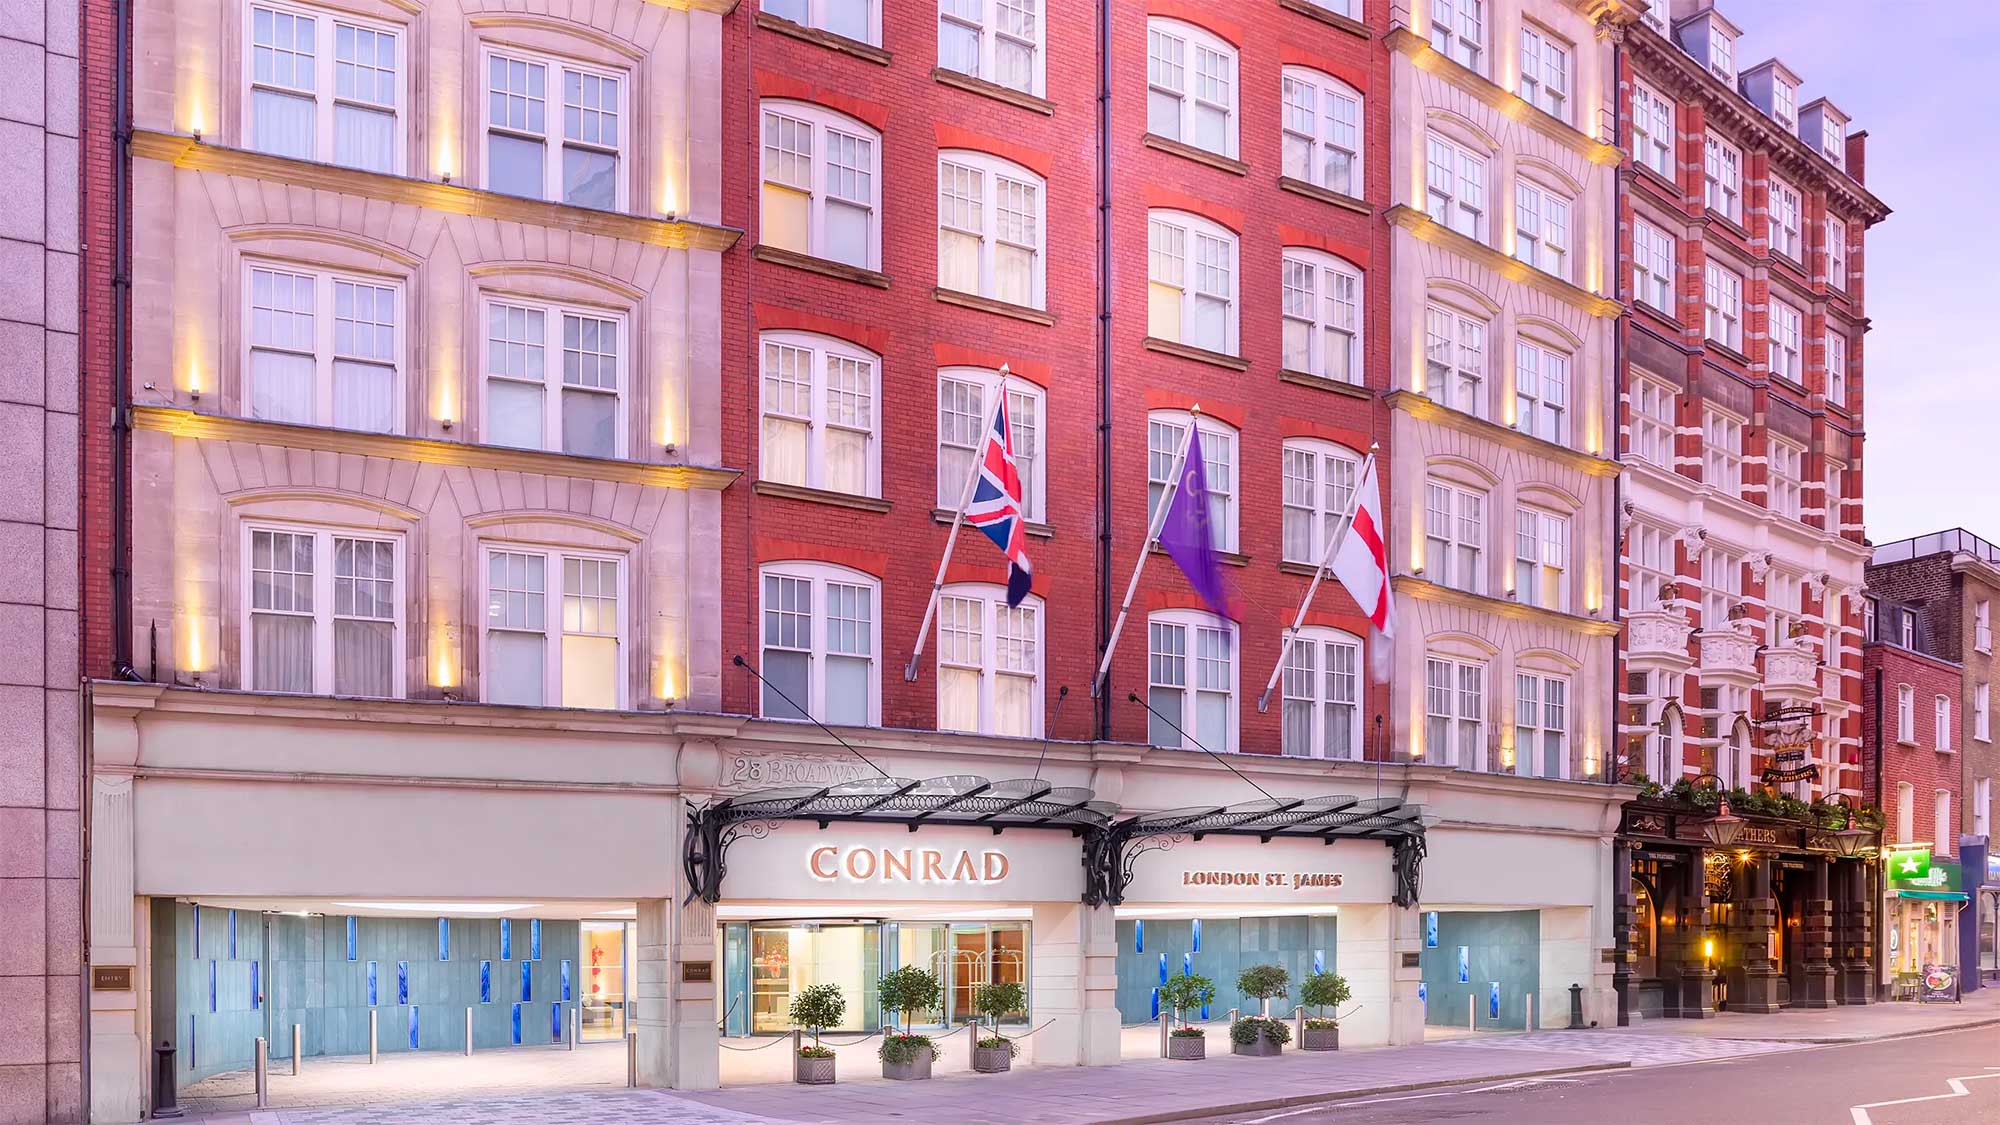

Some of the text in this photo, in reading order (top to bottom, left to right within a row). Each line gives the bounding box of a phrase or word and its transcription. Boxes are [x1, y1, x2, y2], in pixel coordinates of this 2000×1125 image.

[733, 757, 867, 784] 28 BROADWAY
[1767, 768, 1813, 781] FEATHERS
[810, 846, 1009, 881] CONRAD
[1183, 871, 1343, 889] LONDON ST. JAMES
